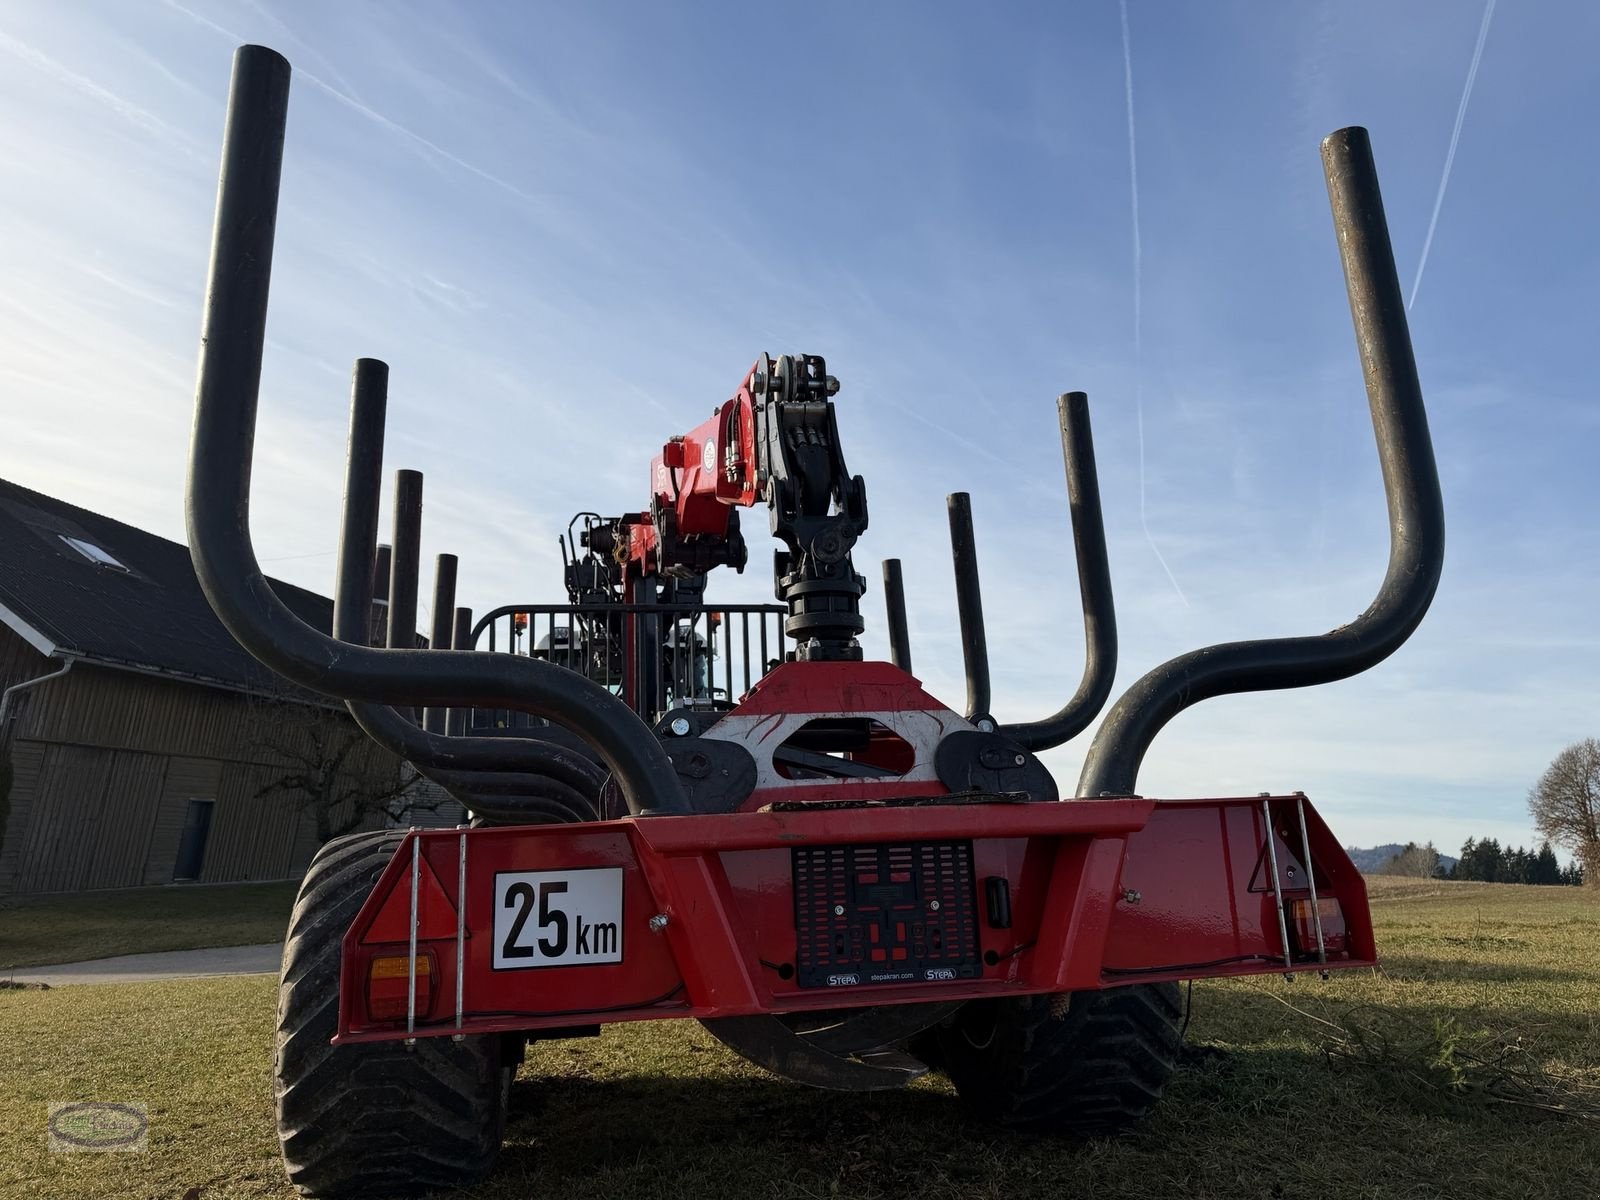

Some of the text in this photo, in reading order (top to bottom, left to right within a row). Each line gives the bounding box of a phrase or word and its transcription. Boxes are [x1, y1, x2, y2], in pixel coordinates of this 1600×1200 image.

[503, 881, 617, 959] 25 km
[828, 974, 857, 985] STEPA
[870, 972, 914, 981] stepakran.com
[926, 969, 954, 980] STEPA
